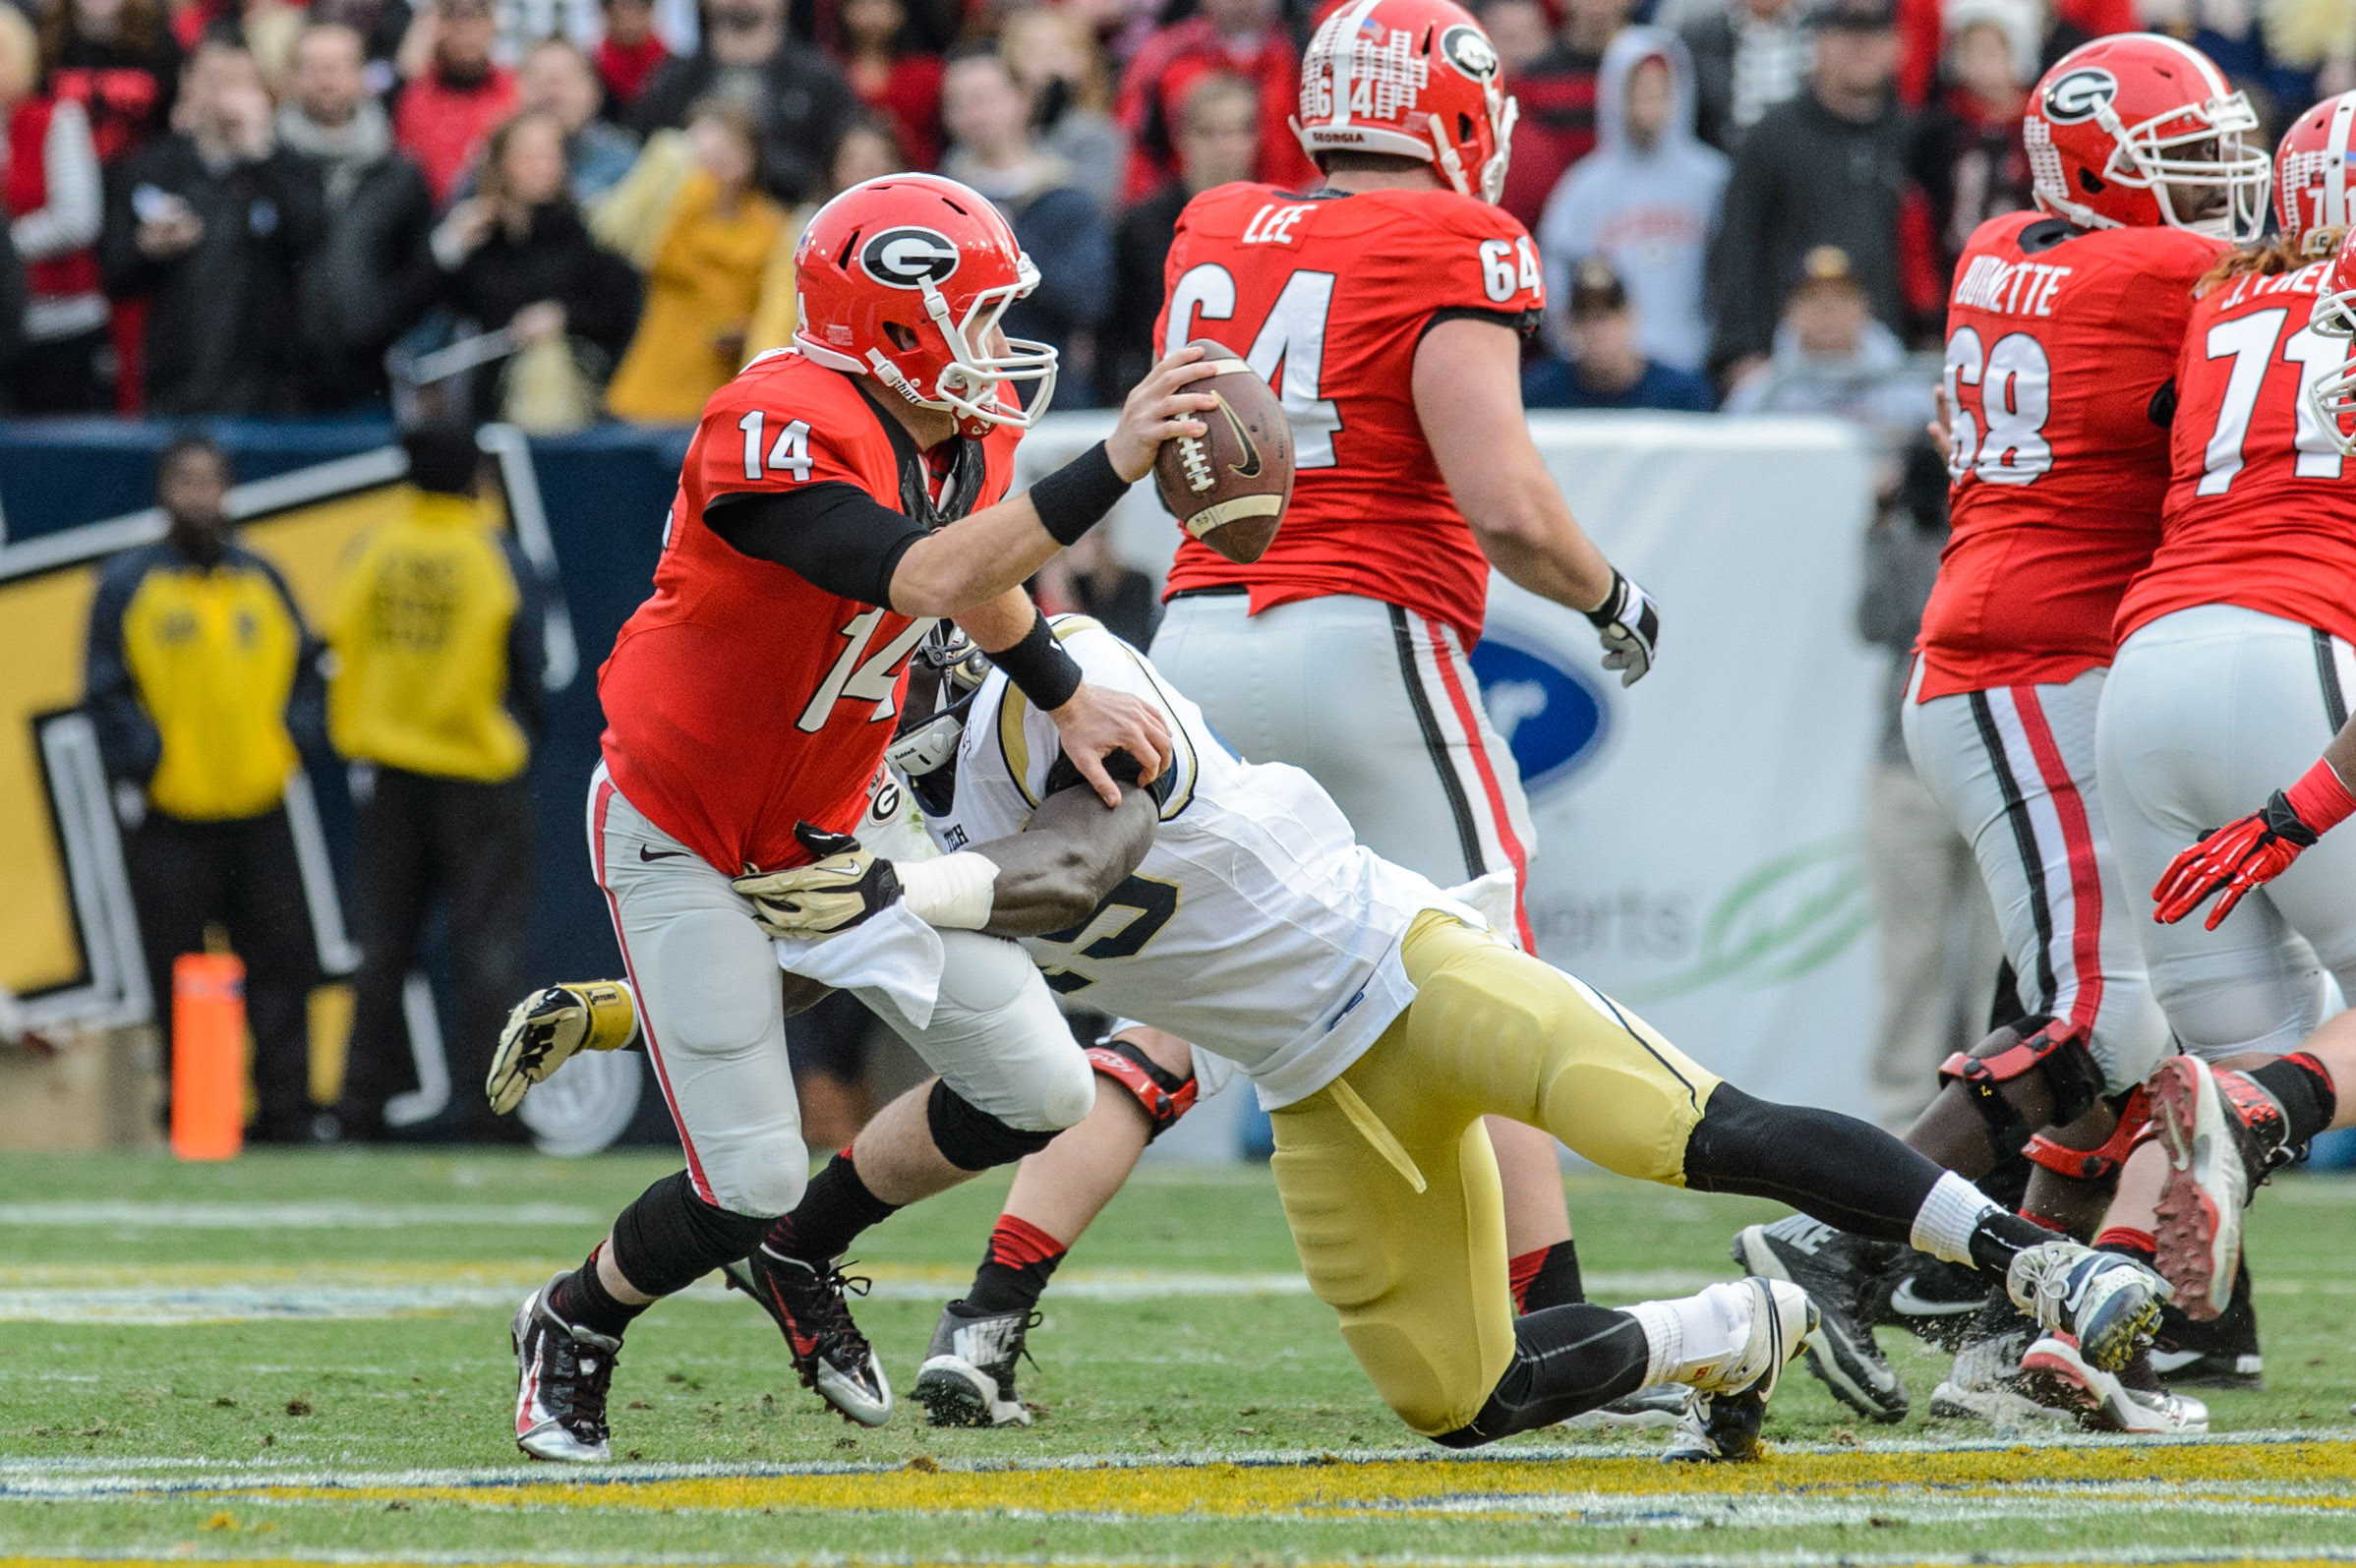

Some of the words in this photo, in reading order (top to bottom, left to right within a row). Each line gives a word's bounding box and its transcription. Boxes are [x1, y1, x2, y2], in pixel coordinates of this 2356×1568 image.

[861, 227, 960, 288] G
[1241, 203, 1319, 245] LEE
[1478, 235, 1541, 303] 64
[1943, 325, 2055, 487] 68
[2195, 307, 2351, 497] 71
[738, 409, 814, 482] 14
[794, 606, 941, 734] 14
[871, 783, 902, 822] G
